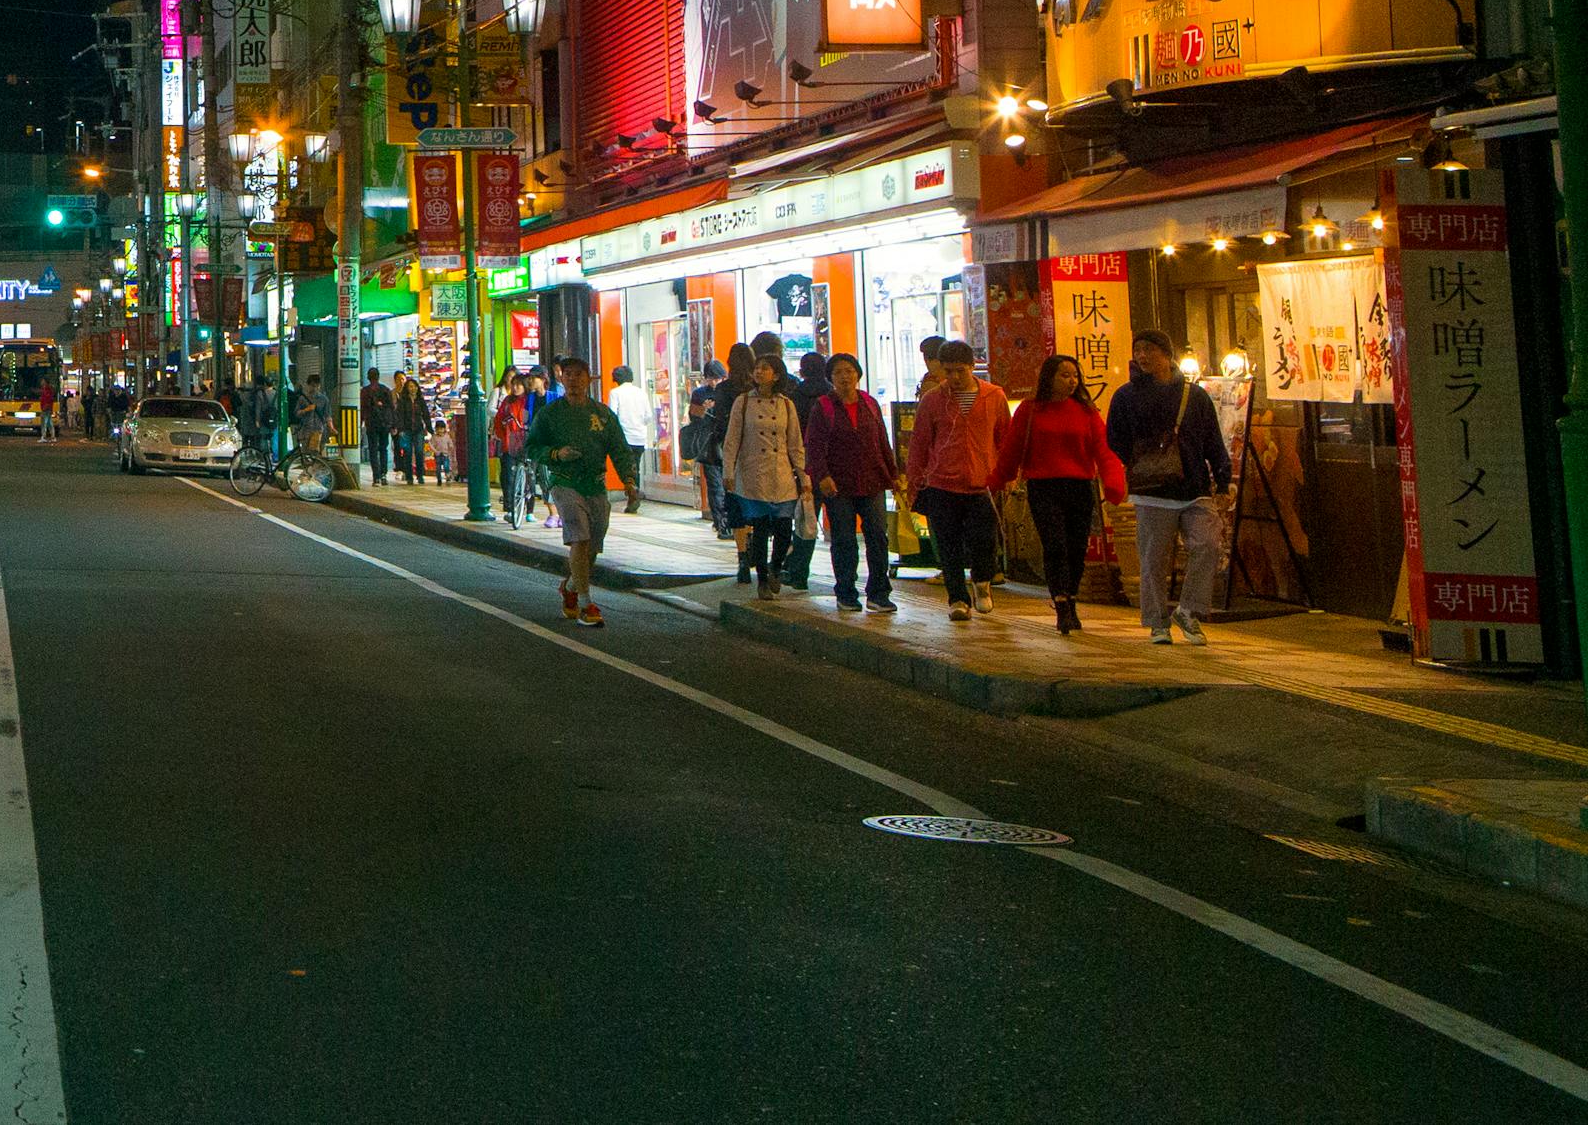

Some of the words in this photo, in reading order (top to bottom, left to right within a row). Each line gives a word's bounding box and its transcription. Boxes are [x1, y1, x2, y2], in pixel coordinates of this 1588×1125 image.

[1183, 66, 1200, 81] NO
[1205, 62, 1242, 79] KUNI
[431, 132, 505, 143] なんさん通り
[1407, 214, 1501, 244] 専門店
[1057, 253, 1121, 276] 専門店
[437, 285, 467, 300] 大阪
[1427, 260, 1501, 552] 味噌ラーメン
[1433, 582, 1531, 615] 専門店
